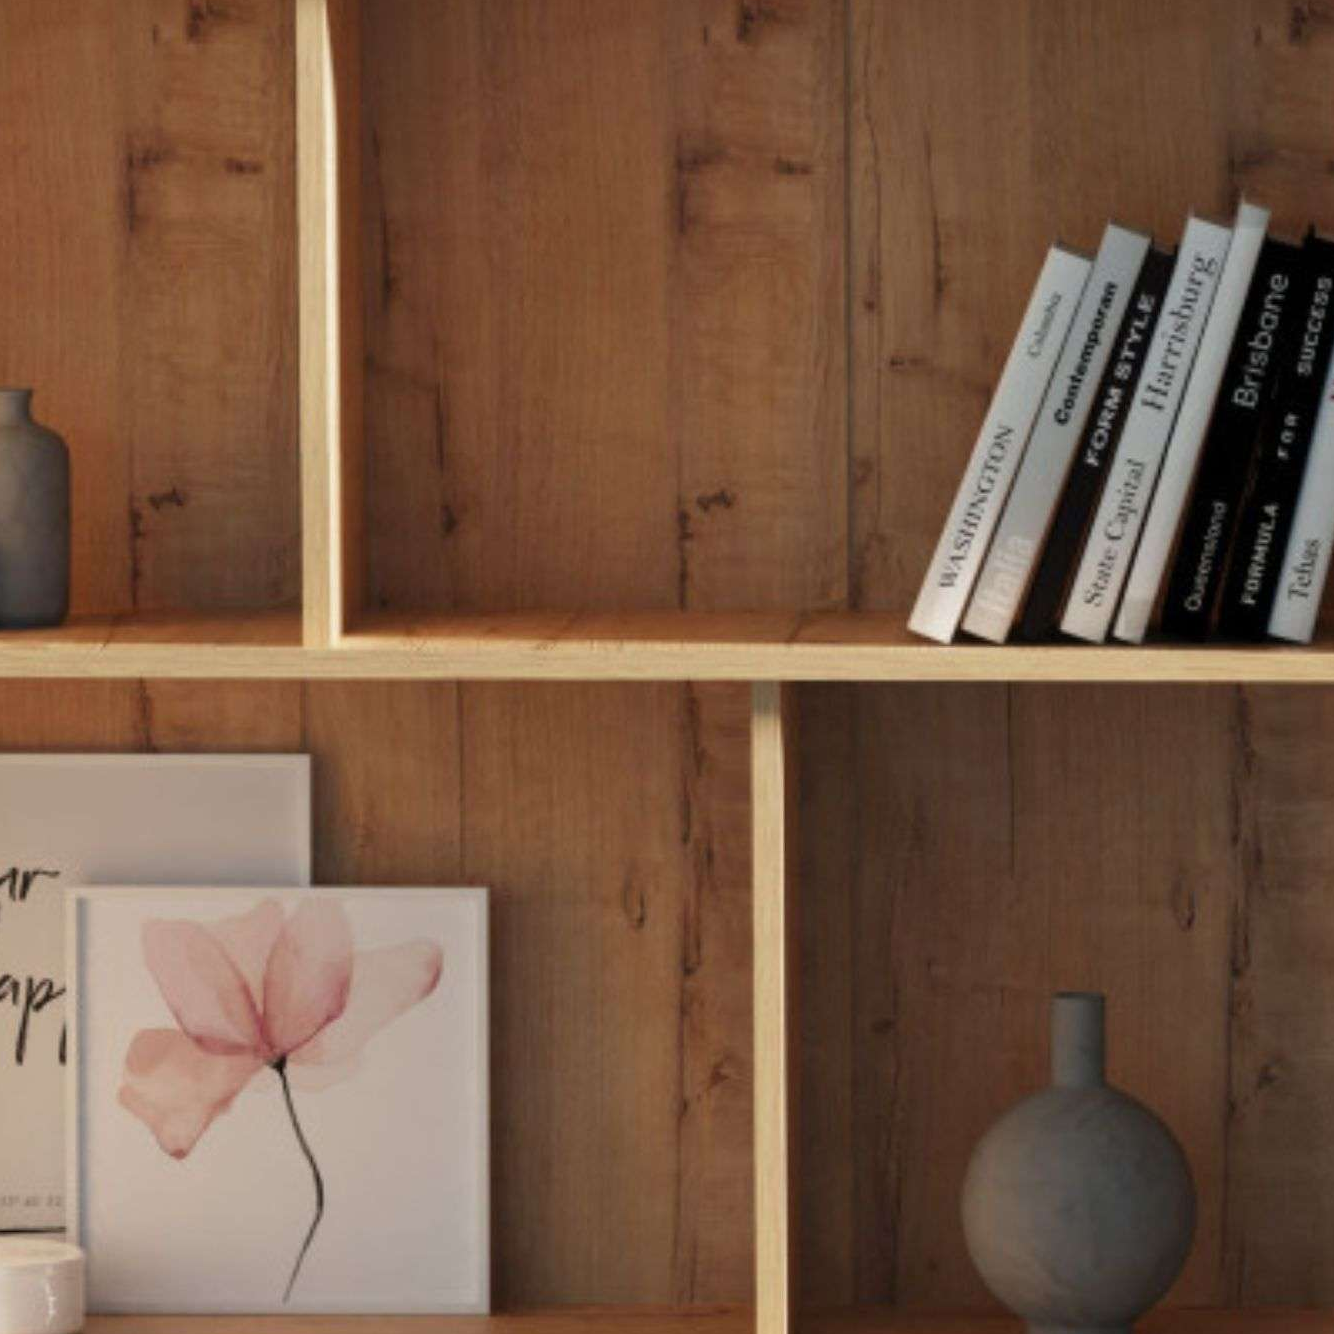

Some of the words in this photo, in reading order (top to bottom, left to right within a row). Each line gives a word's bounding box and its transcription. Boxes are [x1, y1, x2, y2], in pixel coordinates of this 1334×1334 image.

[1085, 386, 1123, 467] FORM
[1113, 293, 1156, 381] STYLE
[1230, 272, 1290, 409] Brisbane
[938, 423, 1015, 589] WASHINGTON
[1083, 547, 1116, 608] State
[1103, 458, 1145, 541] Capital
[1141, 251, 1219, 411] Harrisburg
[1240, 502, 1280, 607] FORMULA
[1297, 276, 1334, 378] SUCCESS
